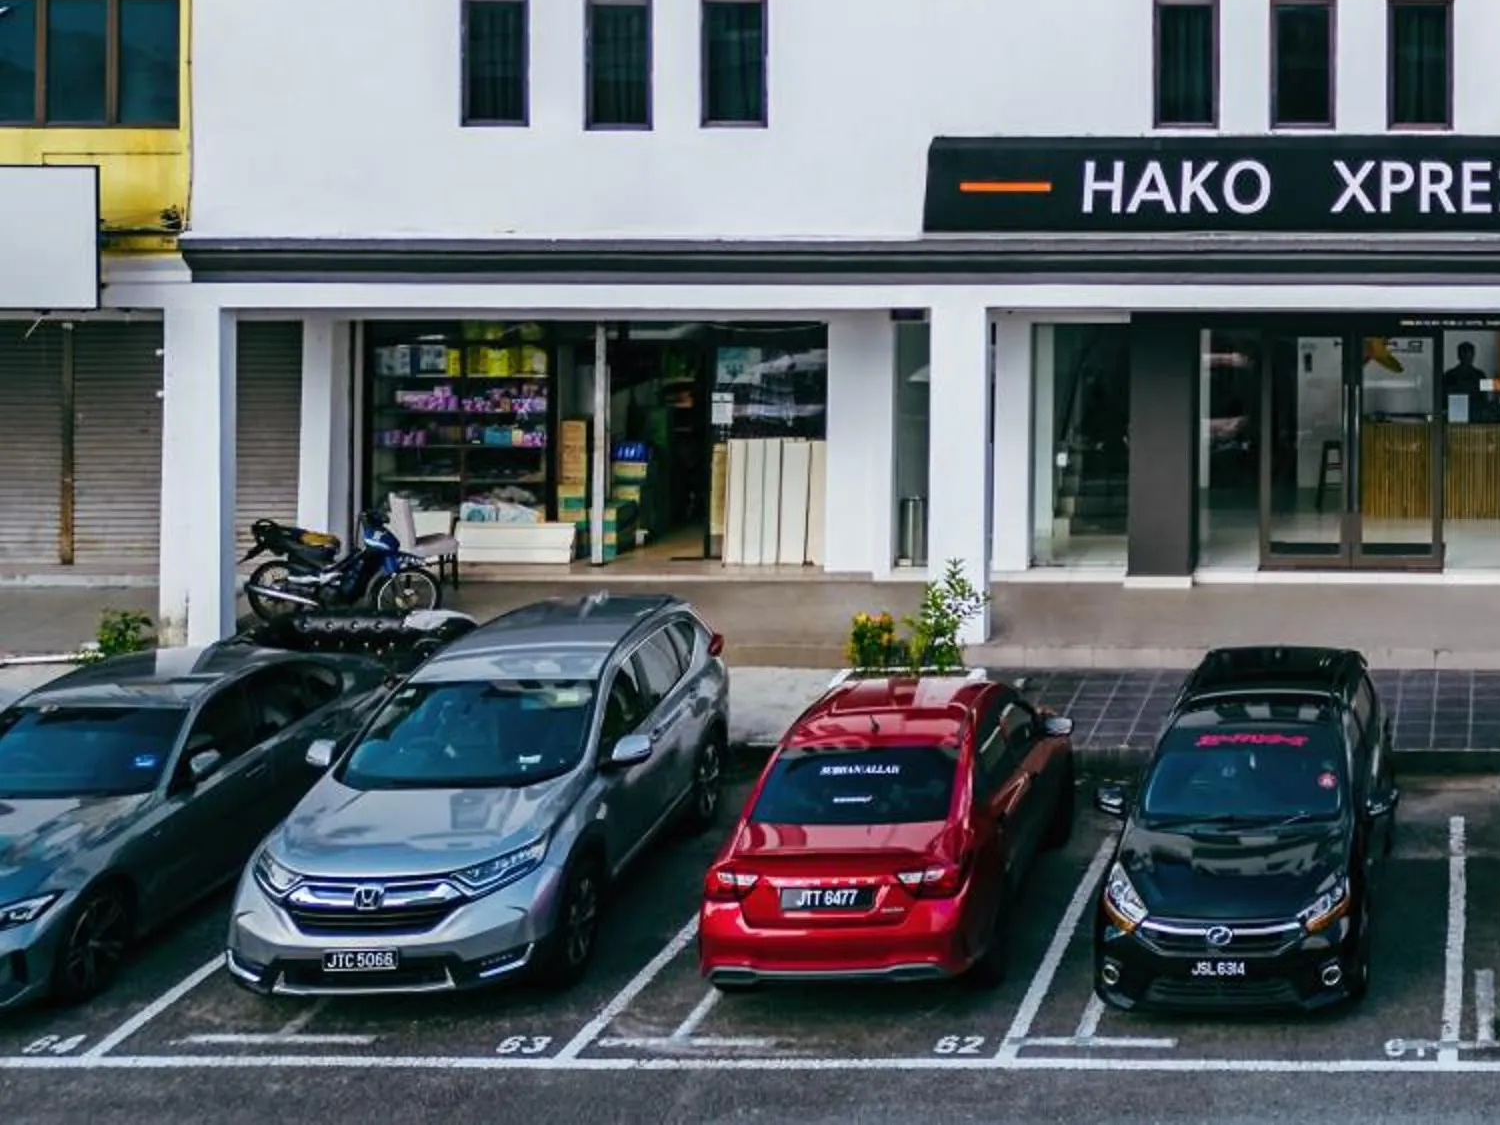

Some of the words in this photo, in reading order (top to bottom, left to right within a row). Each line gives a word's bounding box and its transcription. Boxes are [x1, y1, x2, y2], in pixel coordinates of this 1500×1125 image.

[1082, 160, 1271, 214] HAKO
[796, 890, 822, 906] JTT
[824, 889, 858, 905] 6477
[327, 955, 354, 968] JTC
[496, 1035, 553, 1054] 63
[933, 1034, 985, 1054] 62
